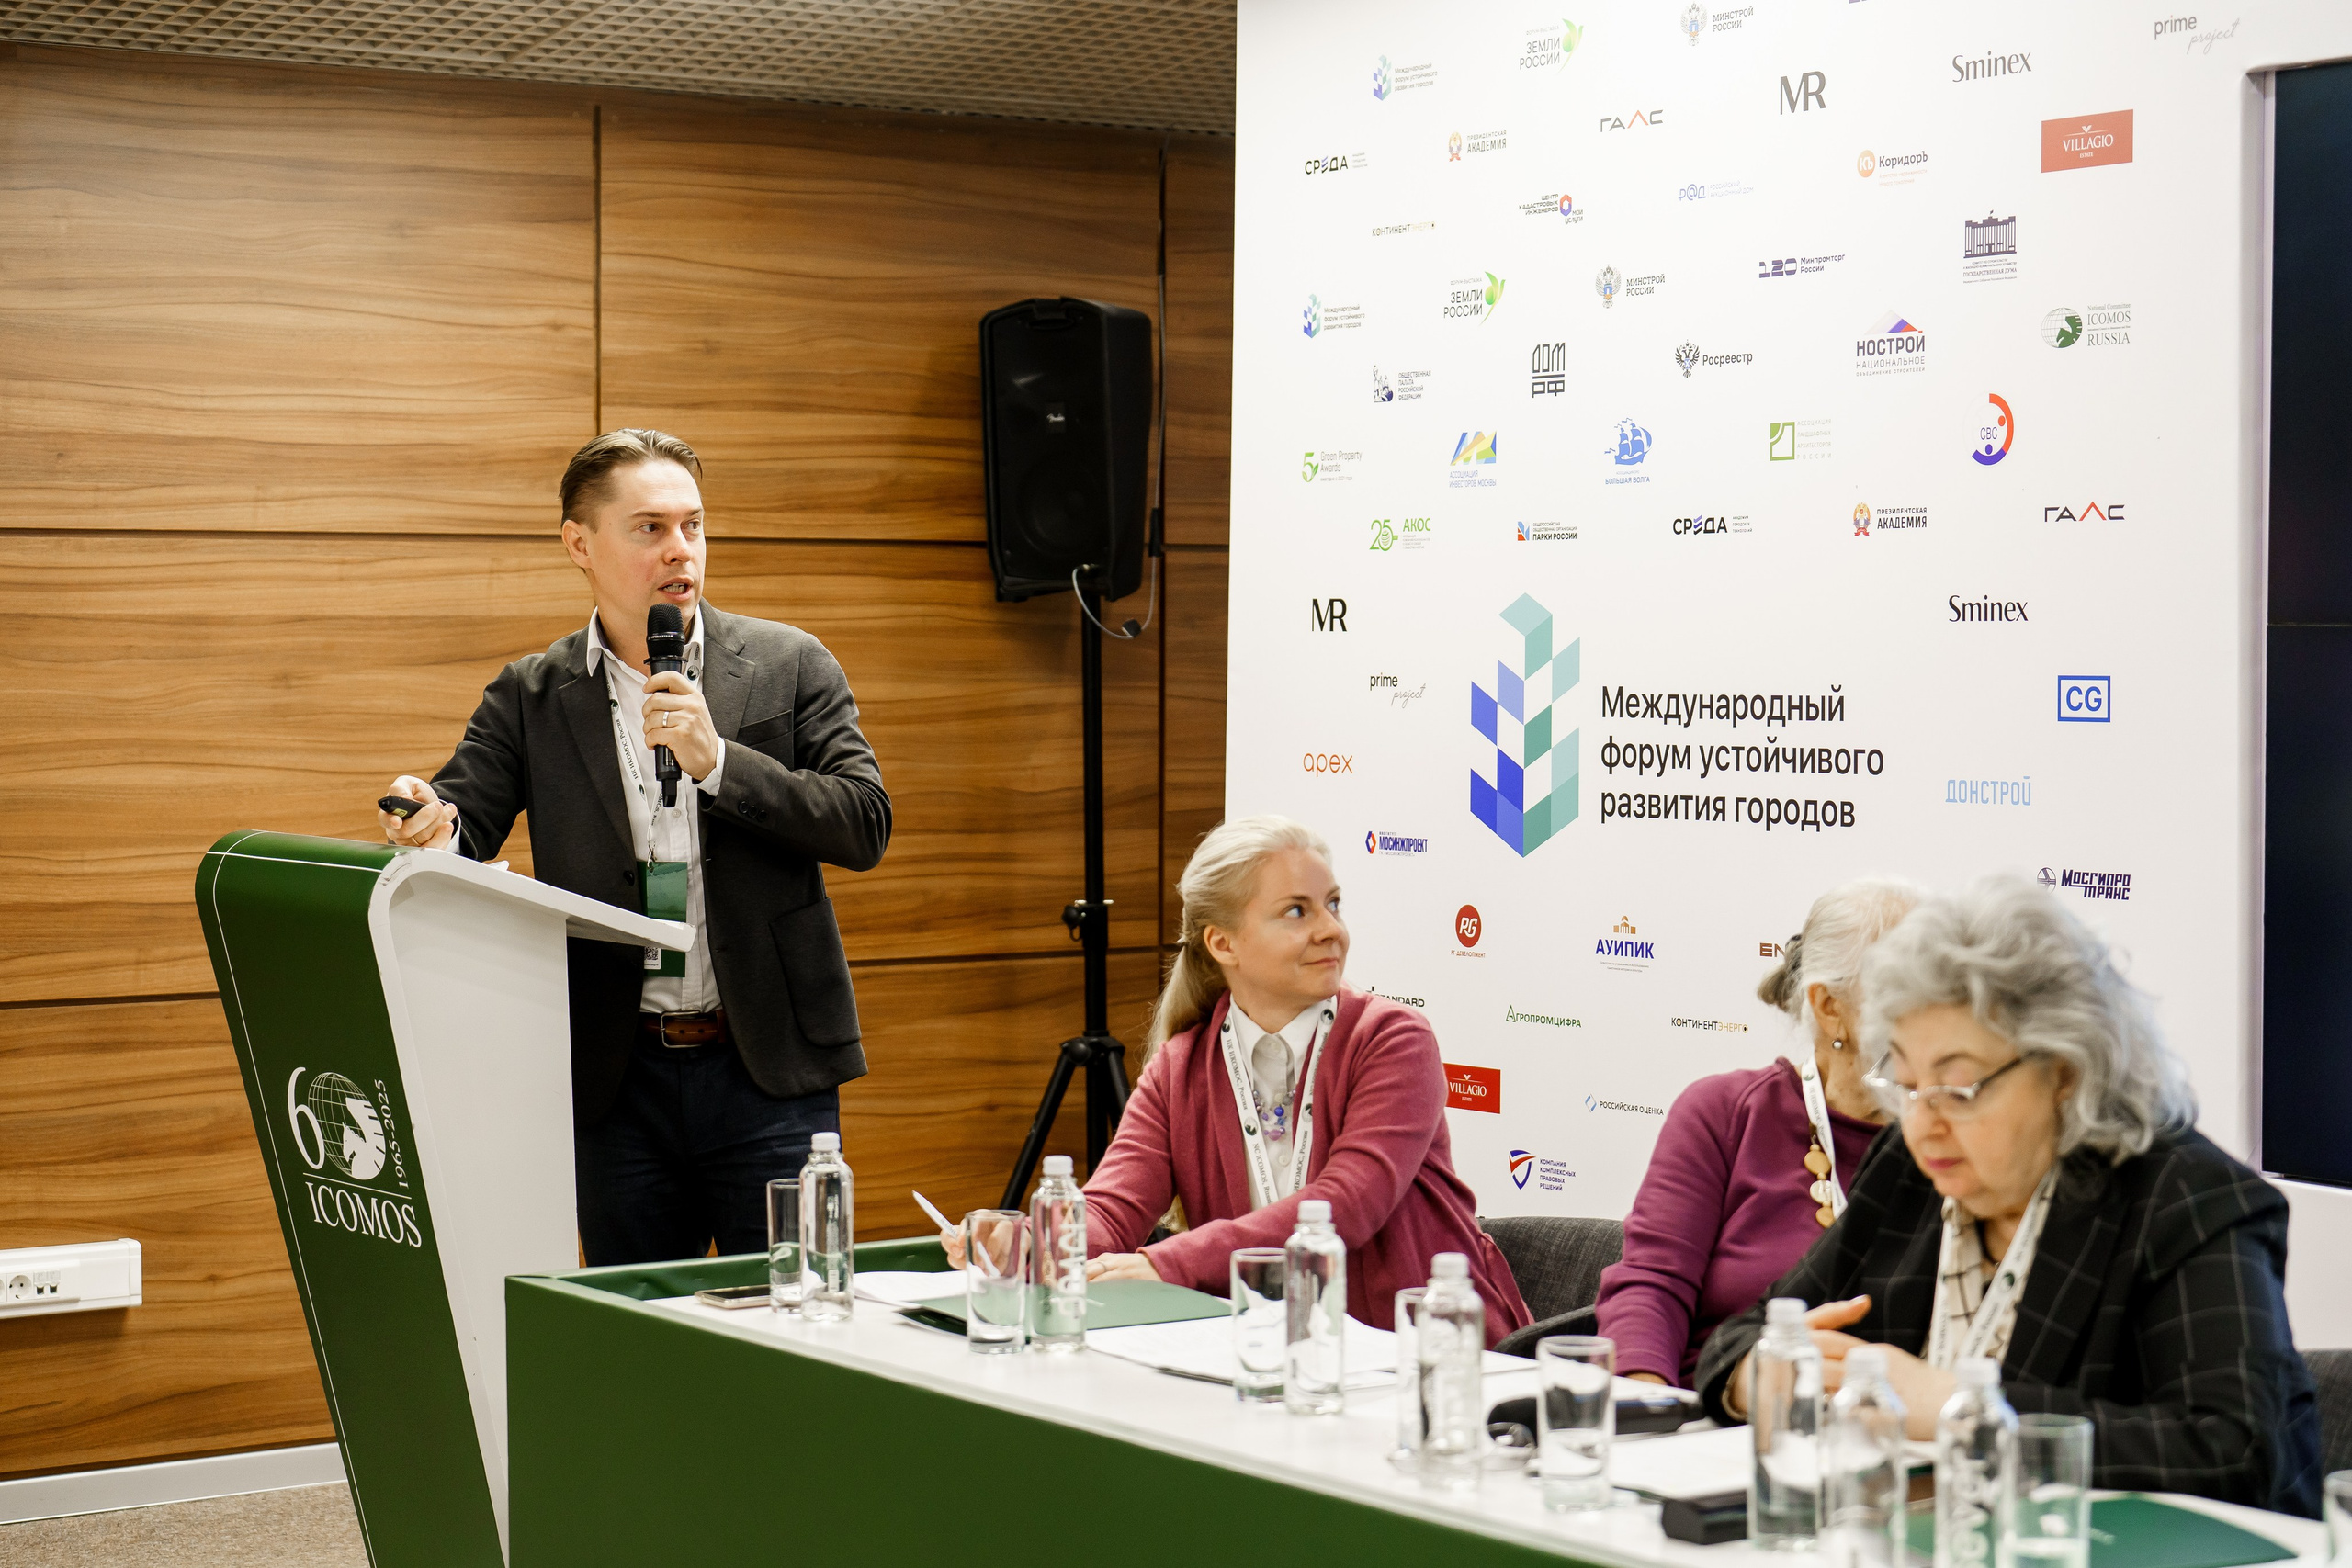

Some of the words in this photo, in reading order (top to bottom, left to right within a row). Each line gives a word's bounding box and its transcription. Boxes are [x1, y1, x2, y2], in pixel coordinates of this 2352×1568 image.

[1713, 6, 1754, 22] МИНСТРОЙ
[1713, 20, 1742, 32] РОССИИ
[2154, 15, 2197, 39] prime
[2187, 17, 2240, 54] project
[1526, 37, 1560, 54] ЗЕМЛИ
[1519, 51, 1560, 70] РОССИИ
[1952, 51, 2032, 83] Sminex
[1780, 71, 1826, 115] MR
[1600, 109, 1664, 132] ГАЛС
[1467, 130, 1507, 141] ПРЕЗИДЕНТСКАЯ
[2063, 134, 2114, 152] VILLAGIO
[1467, 138, 1507, 154] АКАДЕМИЯ
[1305, 155, 1348, 175] СРЕДА
[1519, 200, 1558, 209] КАДАСТРОВЫХ
[1525, 207, 1559, 215] ИНЖЕНЕРОВ
[1800, 254, 1845, 265] Минпромторг
[1758, 258, 1797, 278] 120
[1801, 265, 1825, 274] России
[1626, 273, 1666, 288] МИНСТРОЙ
[1450, 289, 1483, 304] ЗЕМЛИ
[1626, 286, 1655, 297] РОССИИ
[1443, 304, 1483, 319] РОССИИ
[2087, 310, 2131, 325] ICOMOS
[2087, 332, 2131, 346] RUSSIA
[1702, 353, 1753, 367] Росреестр
[1856, 356, 1925, 369] НАЦИОНАЛЬНОЕ
[1398, 370, 1431, 378] ОБЩЕСТВЕННАЯ
[1398, 385, 1424, 393] РОССИЙСКОЙ
[1797, 430, 1831, 438] ЛАНДШАФТНЫХ
[1320, 451, 1338, 462] Green
[1339, 450, 1363, 462] Property
[1320, 463, 1341, 472] Awards
[1450, 470, 1478, 479] АССОЦИАЦИЯ
[1449, 479, 1476, 488] ИНВЕСТОРОВ
[1477, 479, 1497, 487] МОСКВЫ
[1605, 477, 1632, 485] БОЛЬШАЯ
[1633, 476, 1650, 484] ВОЛГА
[1877, 507, 1927, 515] ПРЕЗИДЕНТСКАЯ
[2044, 501, 2125, 522] ГАЛС
[1402, 517, 1431, 532] АКОС
[1673, 514, 1728, 535] СРЕДА
[1877, 516, 1927, 530] АКАДЕМИЯ
[1532, 533, 1552, 541] ПАРКИ
[1312, 598, 1347, 632] MR
[1948, 594, 2029, 623] Sminex
[1370, 672, 1398, 691] prime
[1391, 683, 1426, 709] project
[2066, 686, 2102, 712] CG
[1601, 684, 1845, 728] Международный
[1303, 752, 1353, 777] apex
[1600, 736, 1691, 777] форум
[1699, 736, 1883, 779] устойчивого
[1945, 775, 2031, 806] ДОНСТРОЙ
[1600, 791, 1726, 824] развития
[1735, 796, 1856, 832] городов
[1379, 836, 1428, 852] МОСИНЖПРОЕКТ
[1595, 939, 1654, 959] АУИПИК
[1671, 1017, 1748, 1033] КОНТИНЕНТЭНЕРГО
[1227, 1038, 1233, 1051] НК
[1229, 1051, 1241, 1088] ИКОМОС,
[1449, 1082, 1487, 1097] VILLAGIO
[1238, 1087, 1248, 1111] Россия
[1600, 1101, 1638, 1112] РОССИЙСКАЯ
[1639, 1105, 1664, 1115] ОЦЕНКА
[374, 1079, 409, 1190] 1965-2025
[1252, 1143, 1261, 1154] NC
[1300, 1131, 1308, 1154] Россия
[1256, 1155, 1268, 1186] ICOMOS,
[1540, 1158, 1566, 1168] КОМПАНИЯ
[1540, 1168, 1576, 1177] КОМПЛЕКСНЫХ
[1540, 1175, 1565, 1184] ПРАВОВЫХ
[1540, 1183, 1563, 1191] РЕШЕНИЙ
[305, 1182, 422, 1248] ICOMOS
